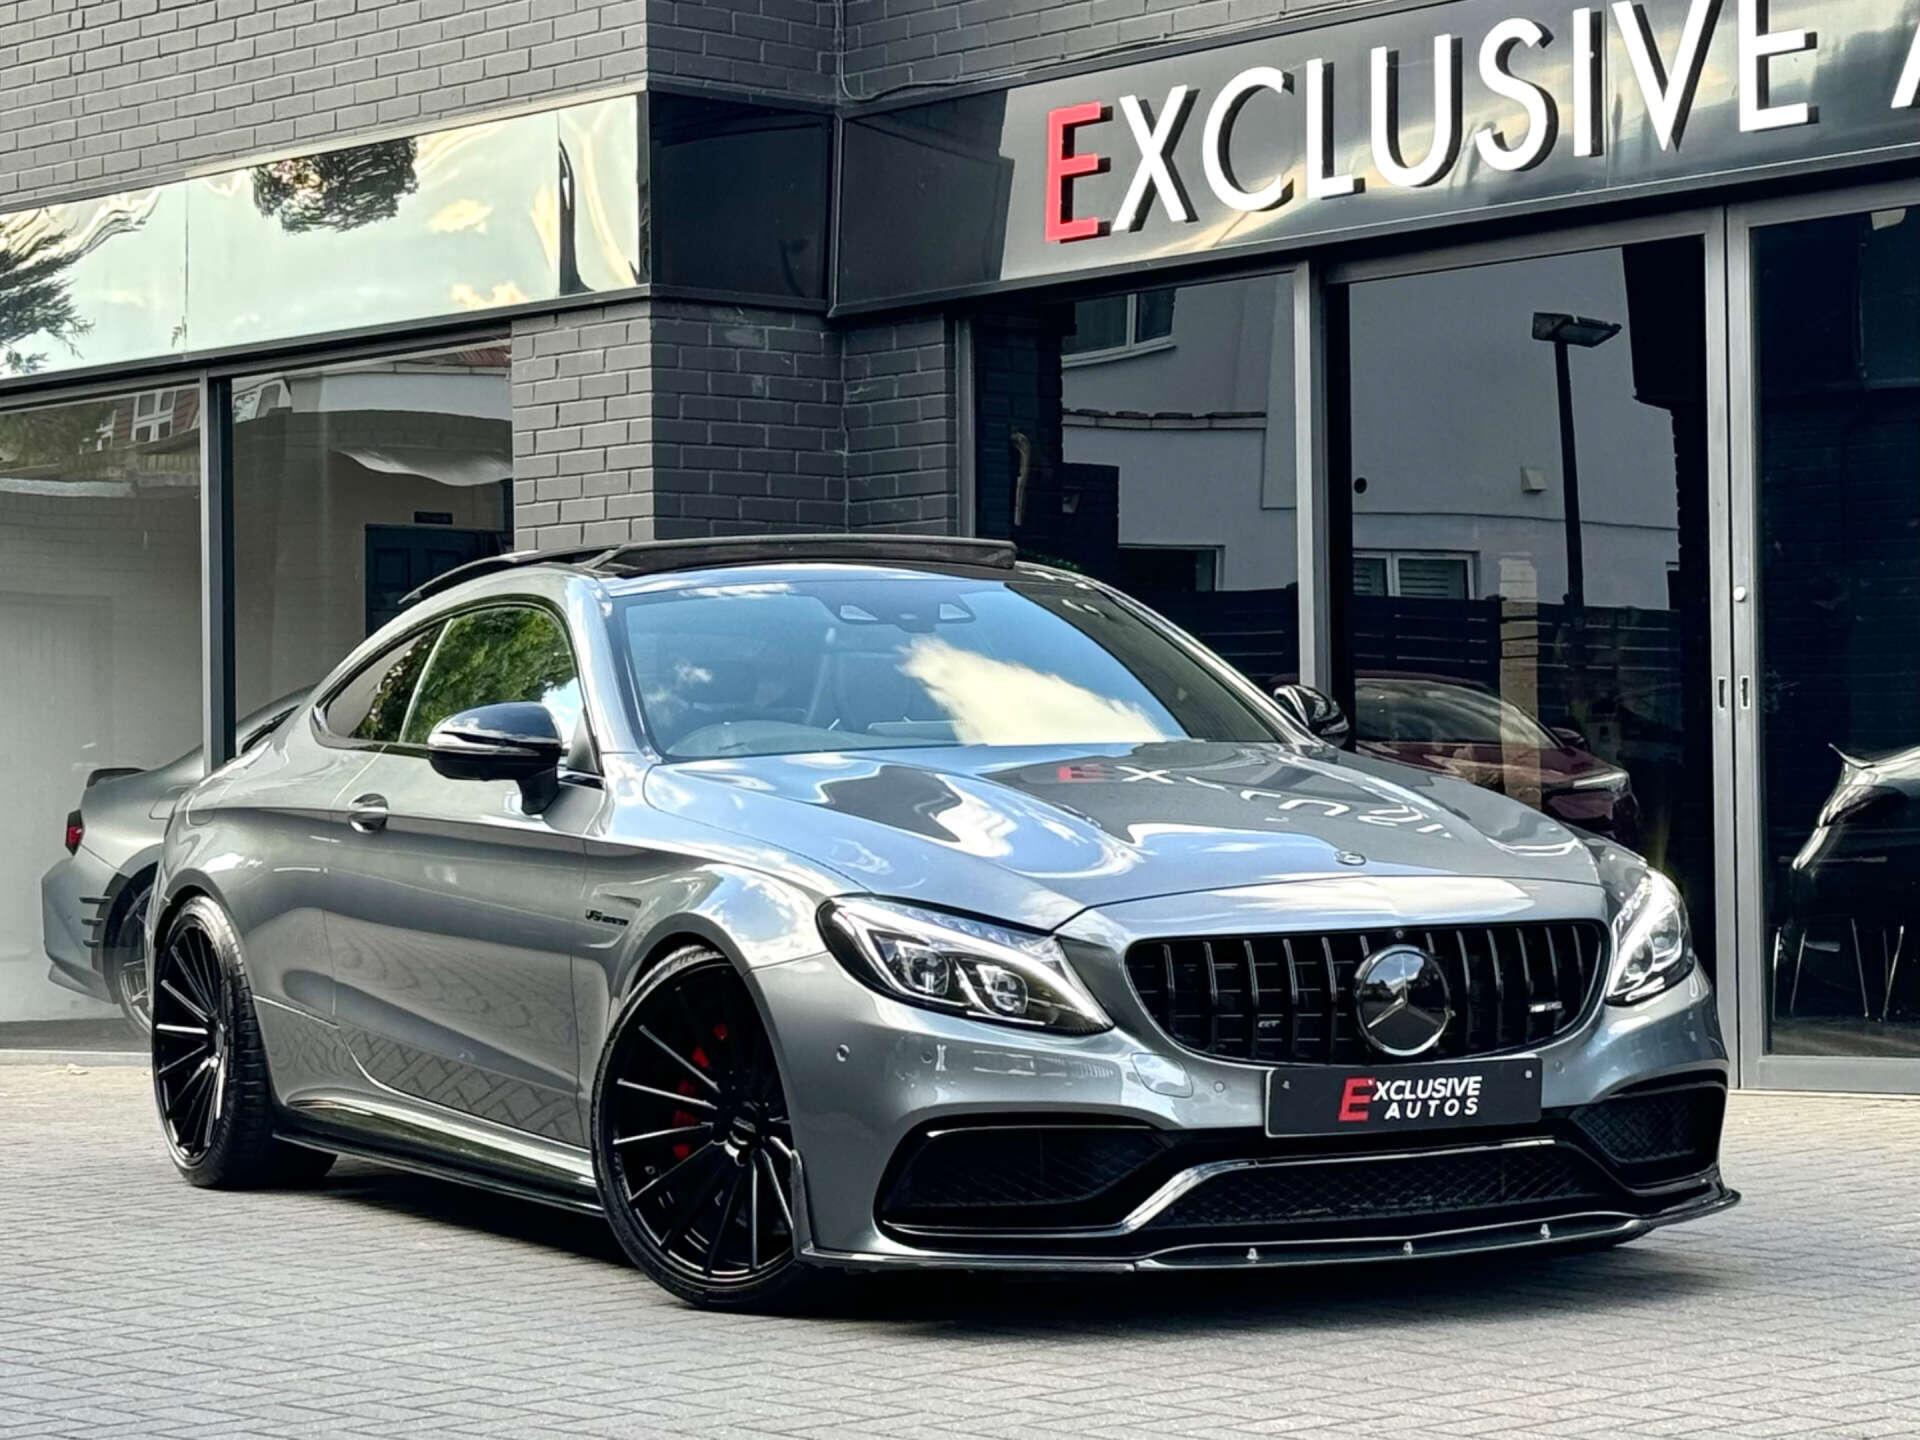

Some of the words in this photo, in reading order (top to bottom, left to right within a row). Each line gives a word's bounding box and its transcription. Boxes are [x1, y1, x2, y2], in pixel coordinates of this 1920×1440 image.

[1045, 0, 1808, 242] EXCLUSIVE
[1340, 1076, 1483, 1122] EXCLUSIVE
[1385, 1098, 1478, 1120] AUTOS
